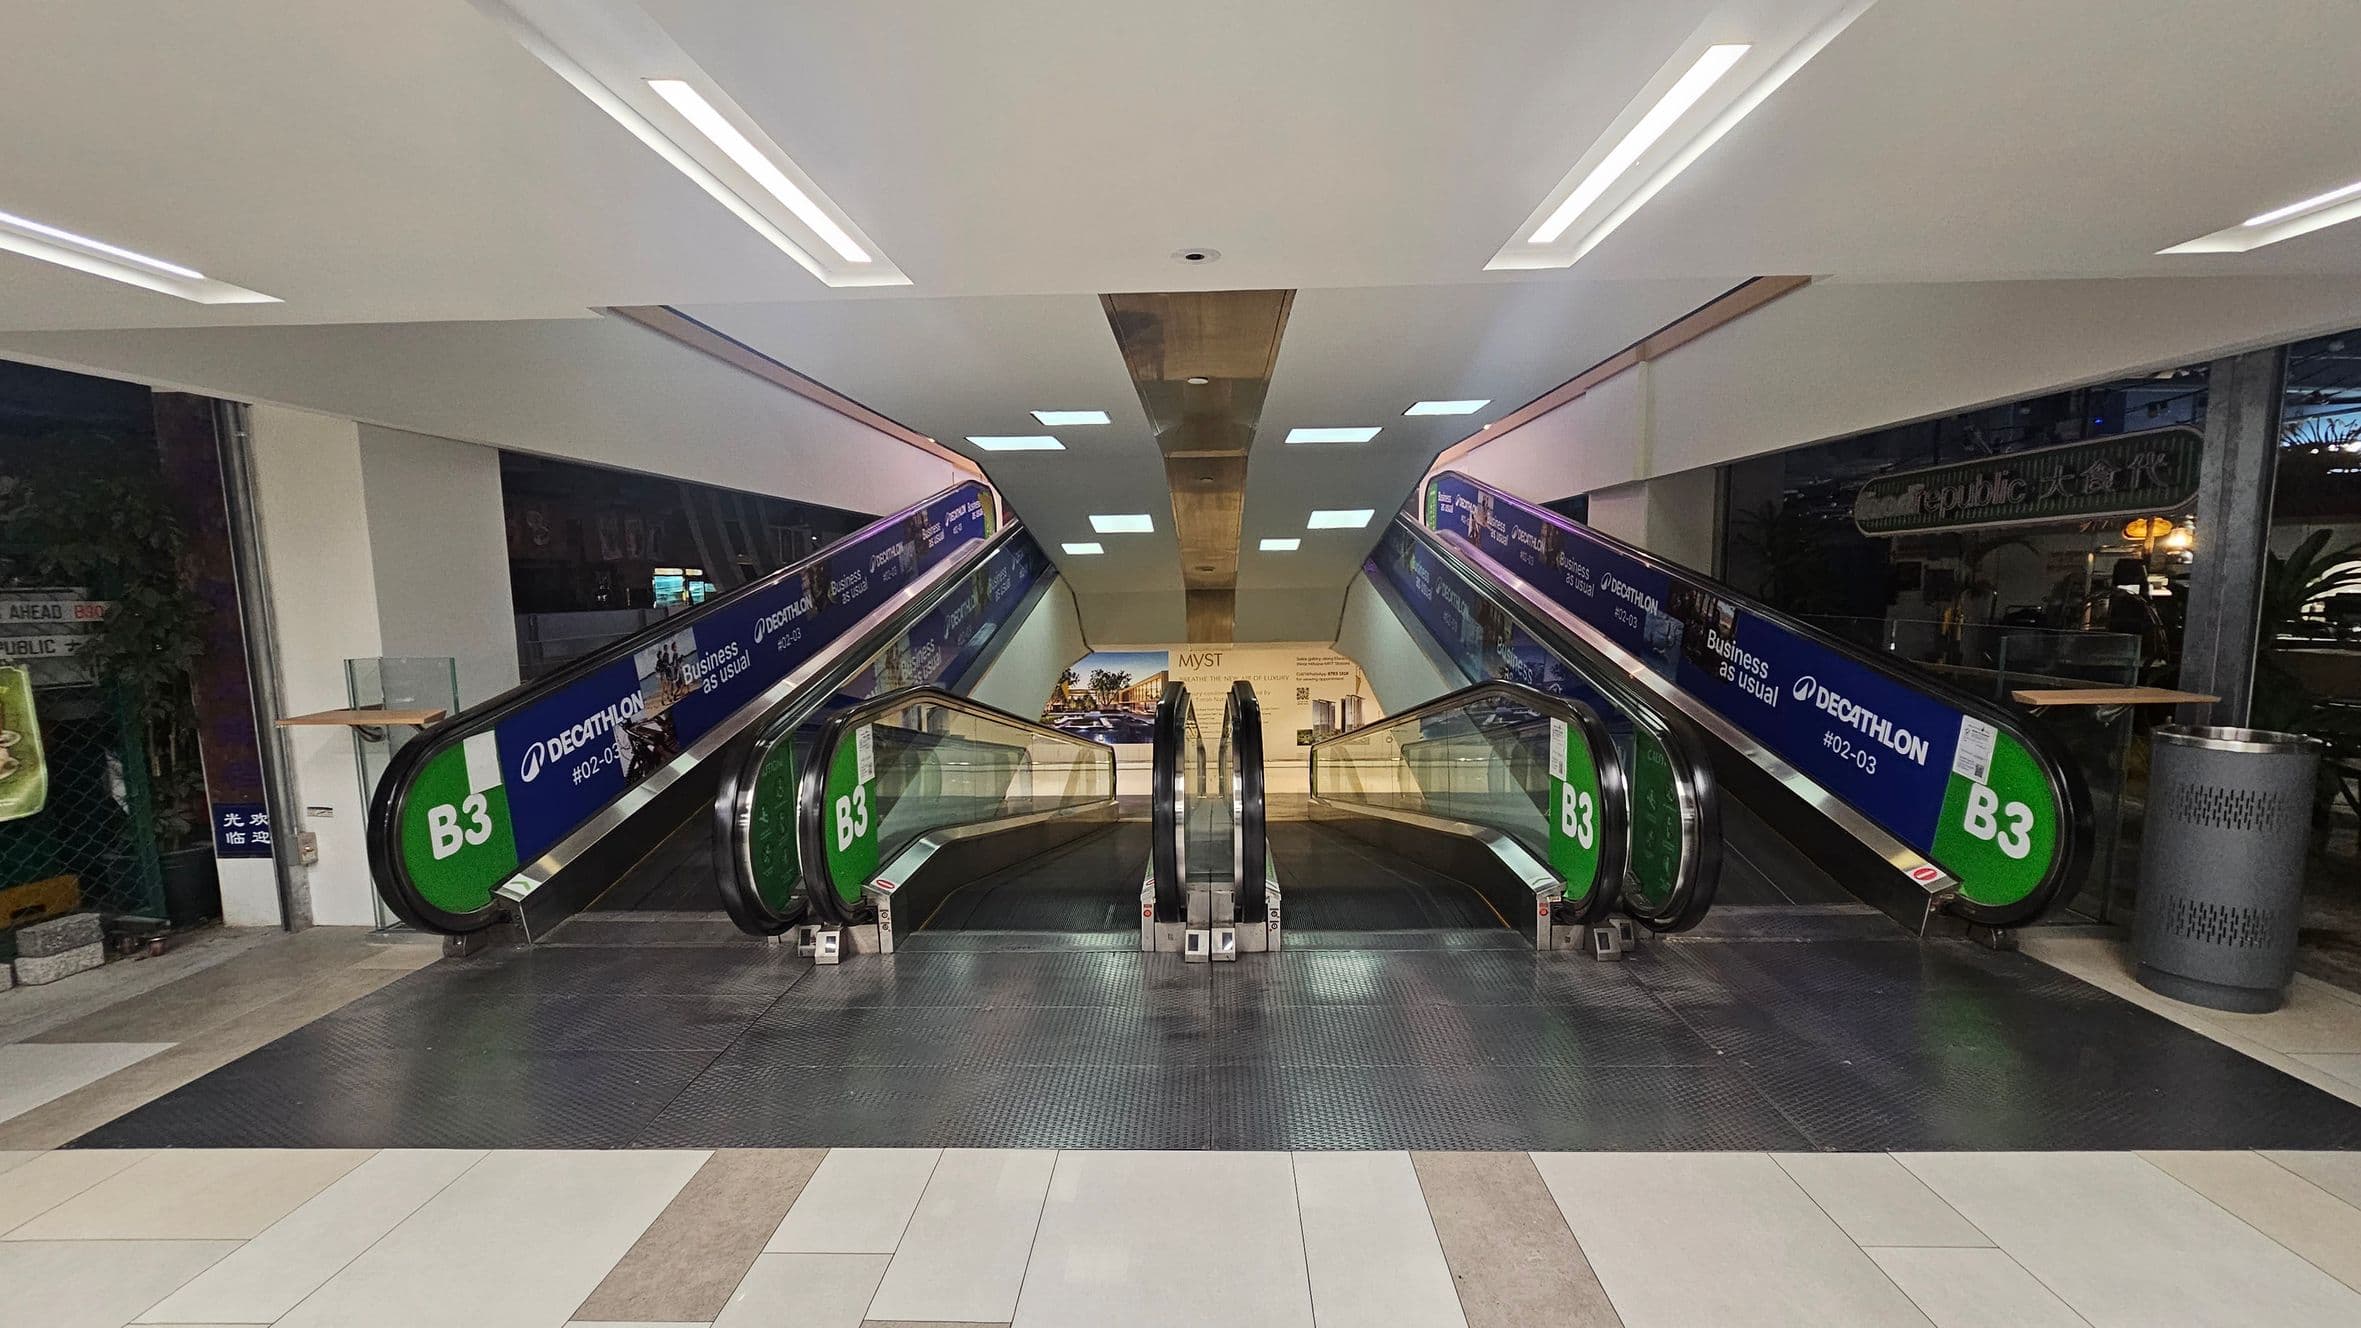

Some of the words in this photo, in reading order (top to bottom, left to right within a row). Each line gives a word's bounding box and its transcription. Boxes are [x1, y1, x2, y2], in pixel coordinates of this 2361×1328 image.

[2039, 452, 2172, 499] 大食代
[830, 569, 862, 596] Business
[1559, 551, 1590, 580] Business
[1565, 572, 1574, 586] as
[1574, 577, 1595, 598] usual
[9, 604, 63, 619] AHEAD
[842, 591, 851, 604] as
[850, 577, 868, 597] usual
[1611, 578, 1658, 615] DECATHLON
[766, 594, 813, 633] DECATHLON
[1614, 608, 1638, 629] #02-03
[777, 627, 802, 651] #02-03
[1497, 636, 1533, 684] Business
[1706, 629, 1769, 679] Business
[682, 641, 739, 684] Business
[703, 675, 718, 694] as
[720, 649, 751, 682] usual
[1719, 661, 1735, 682] as
[1738, 675, 1779, 707] usual
[547, 690, 645, 763] DECATHLON
[1815, 686, 1929, 766] DECATHLON
[572, 742, 621, 786] #02-03
[1823, 730, 1877, 775] #02-03
[223, 812, 246, 844] 光临
[249, 812, 271, 844] 欢迎
[428, 793, 492, 860] B3
[836, 784, 869, 852] B3
[1562, 781, 1593, 849] B3
[1964, 782, 2034, 859] B3
